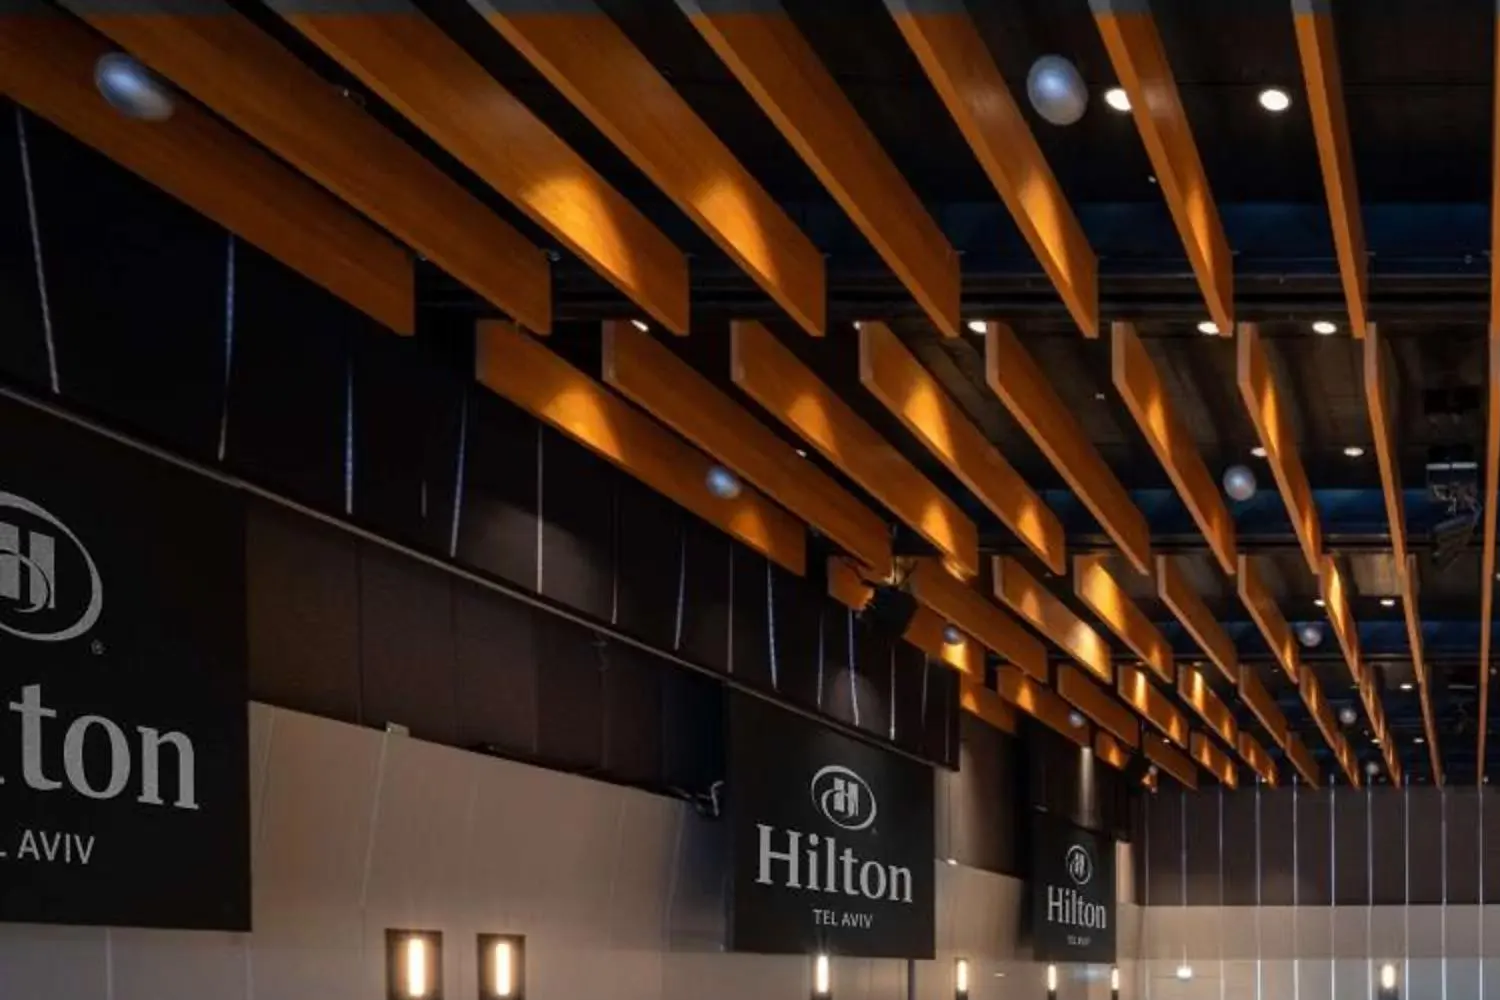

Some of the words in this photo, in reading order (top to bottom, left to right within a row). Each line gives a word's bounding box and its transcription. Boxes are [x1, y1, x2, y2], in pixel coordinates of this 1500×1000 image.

[0, 684, 199, 810] ton
[17, 829, 95, 864] AVIV
[755, 823, 913, 903] Hilton
[812, 909, 839, 926] TEL
[841, 912, 874, 929] AVIV
[1047, 885, 1107, 929] Hilton
